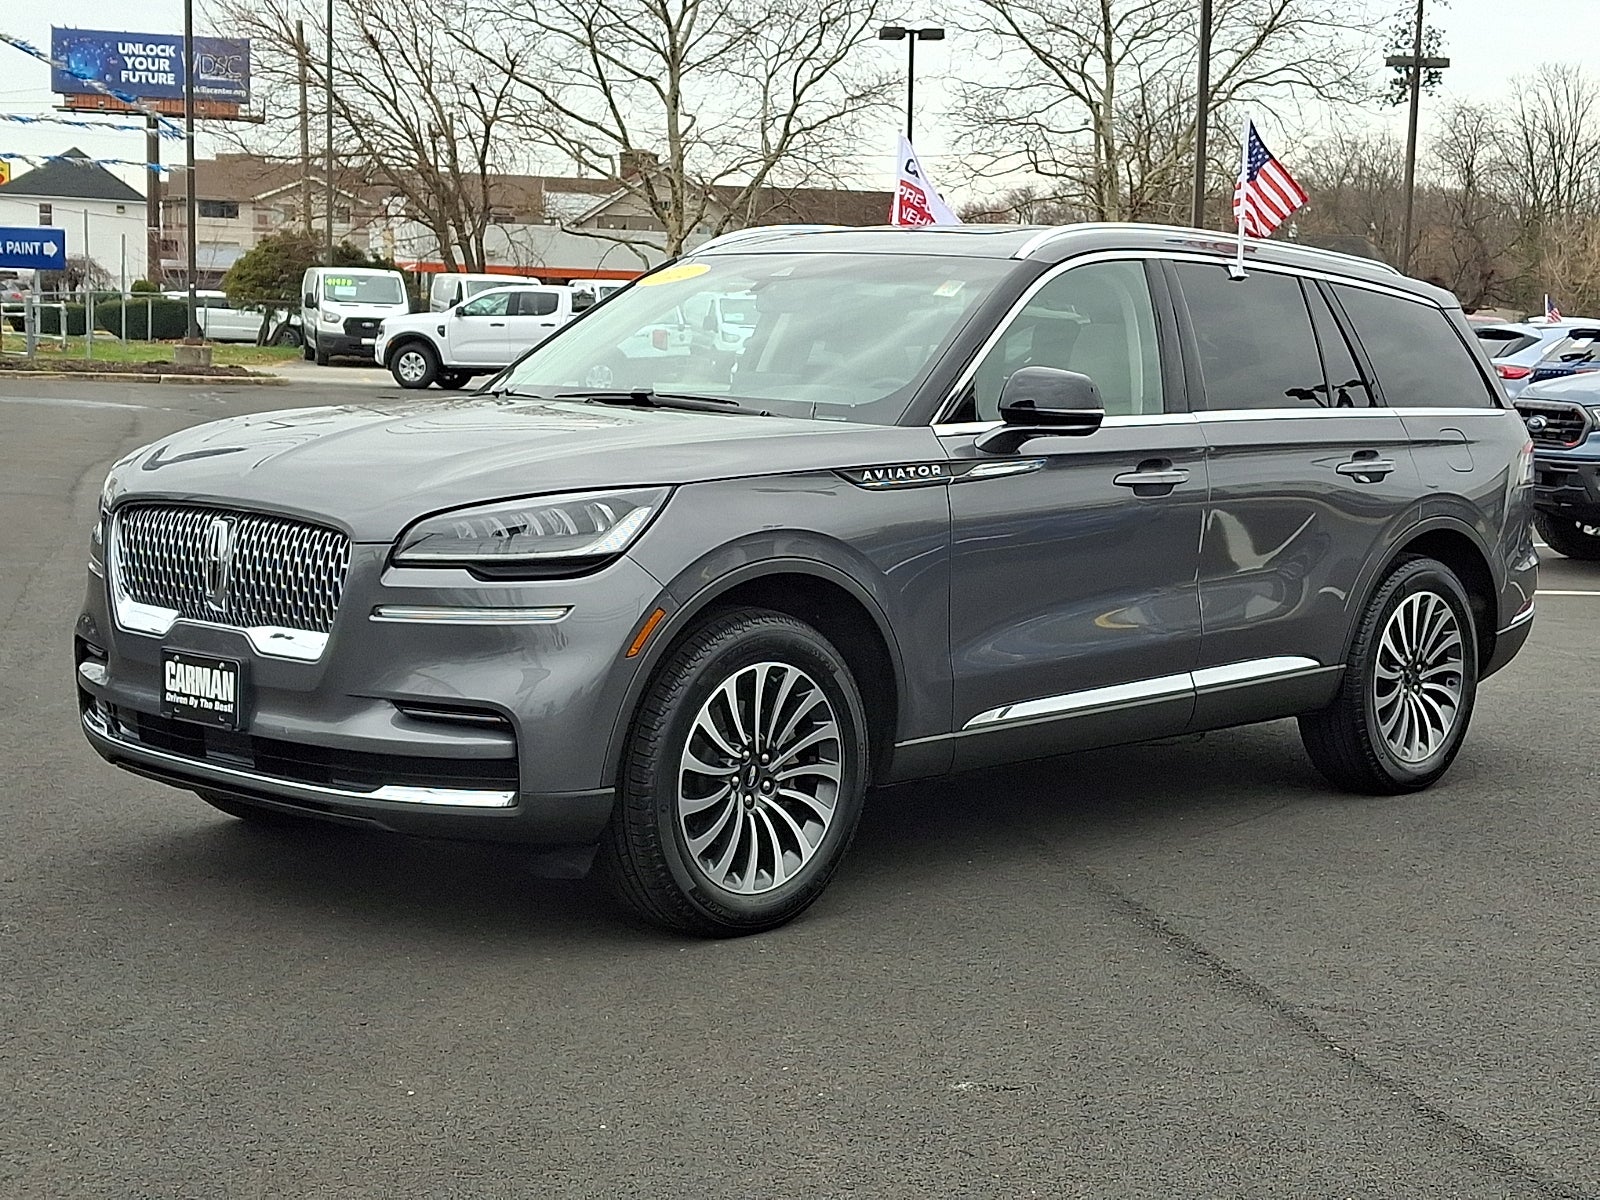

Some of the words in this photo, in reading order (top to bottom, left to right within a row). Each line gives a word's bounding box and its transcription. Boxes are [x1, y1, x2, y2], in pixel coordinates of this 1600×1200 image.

[117, 42, 176, 57] UNLOCK
[123, 56, 170, 71] YOUR
[120, 70, 175, 85] FUTURE
[6, 241, 40, 255] PAINT
[862, 464, 941, 481] AVIATOR
[165, 660, 234, 702] CARMAN
[165, 692, 188, 705] Driven
[189, 696, 198, 708] By
[200, 698, 213, 709] The
[214, 701, 234, 713] Best!
